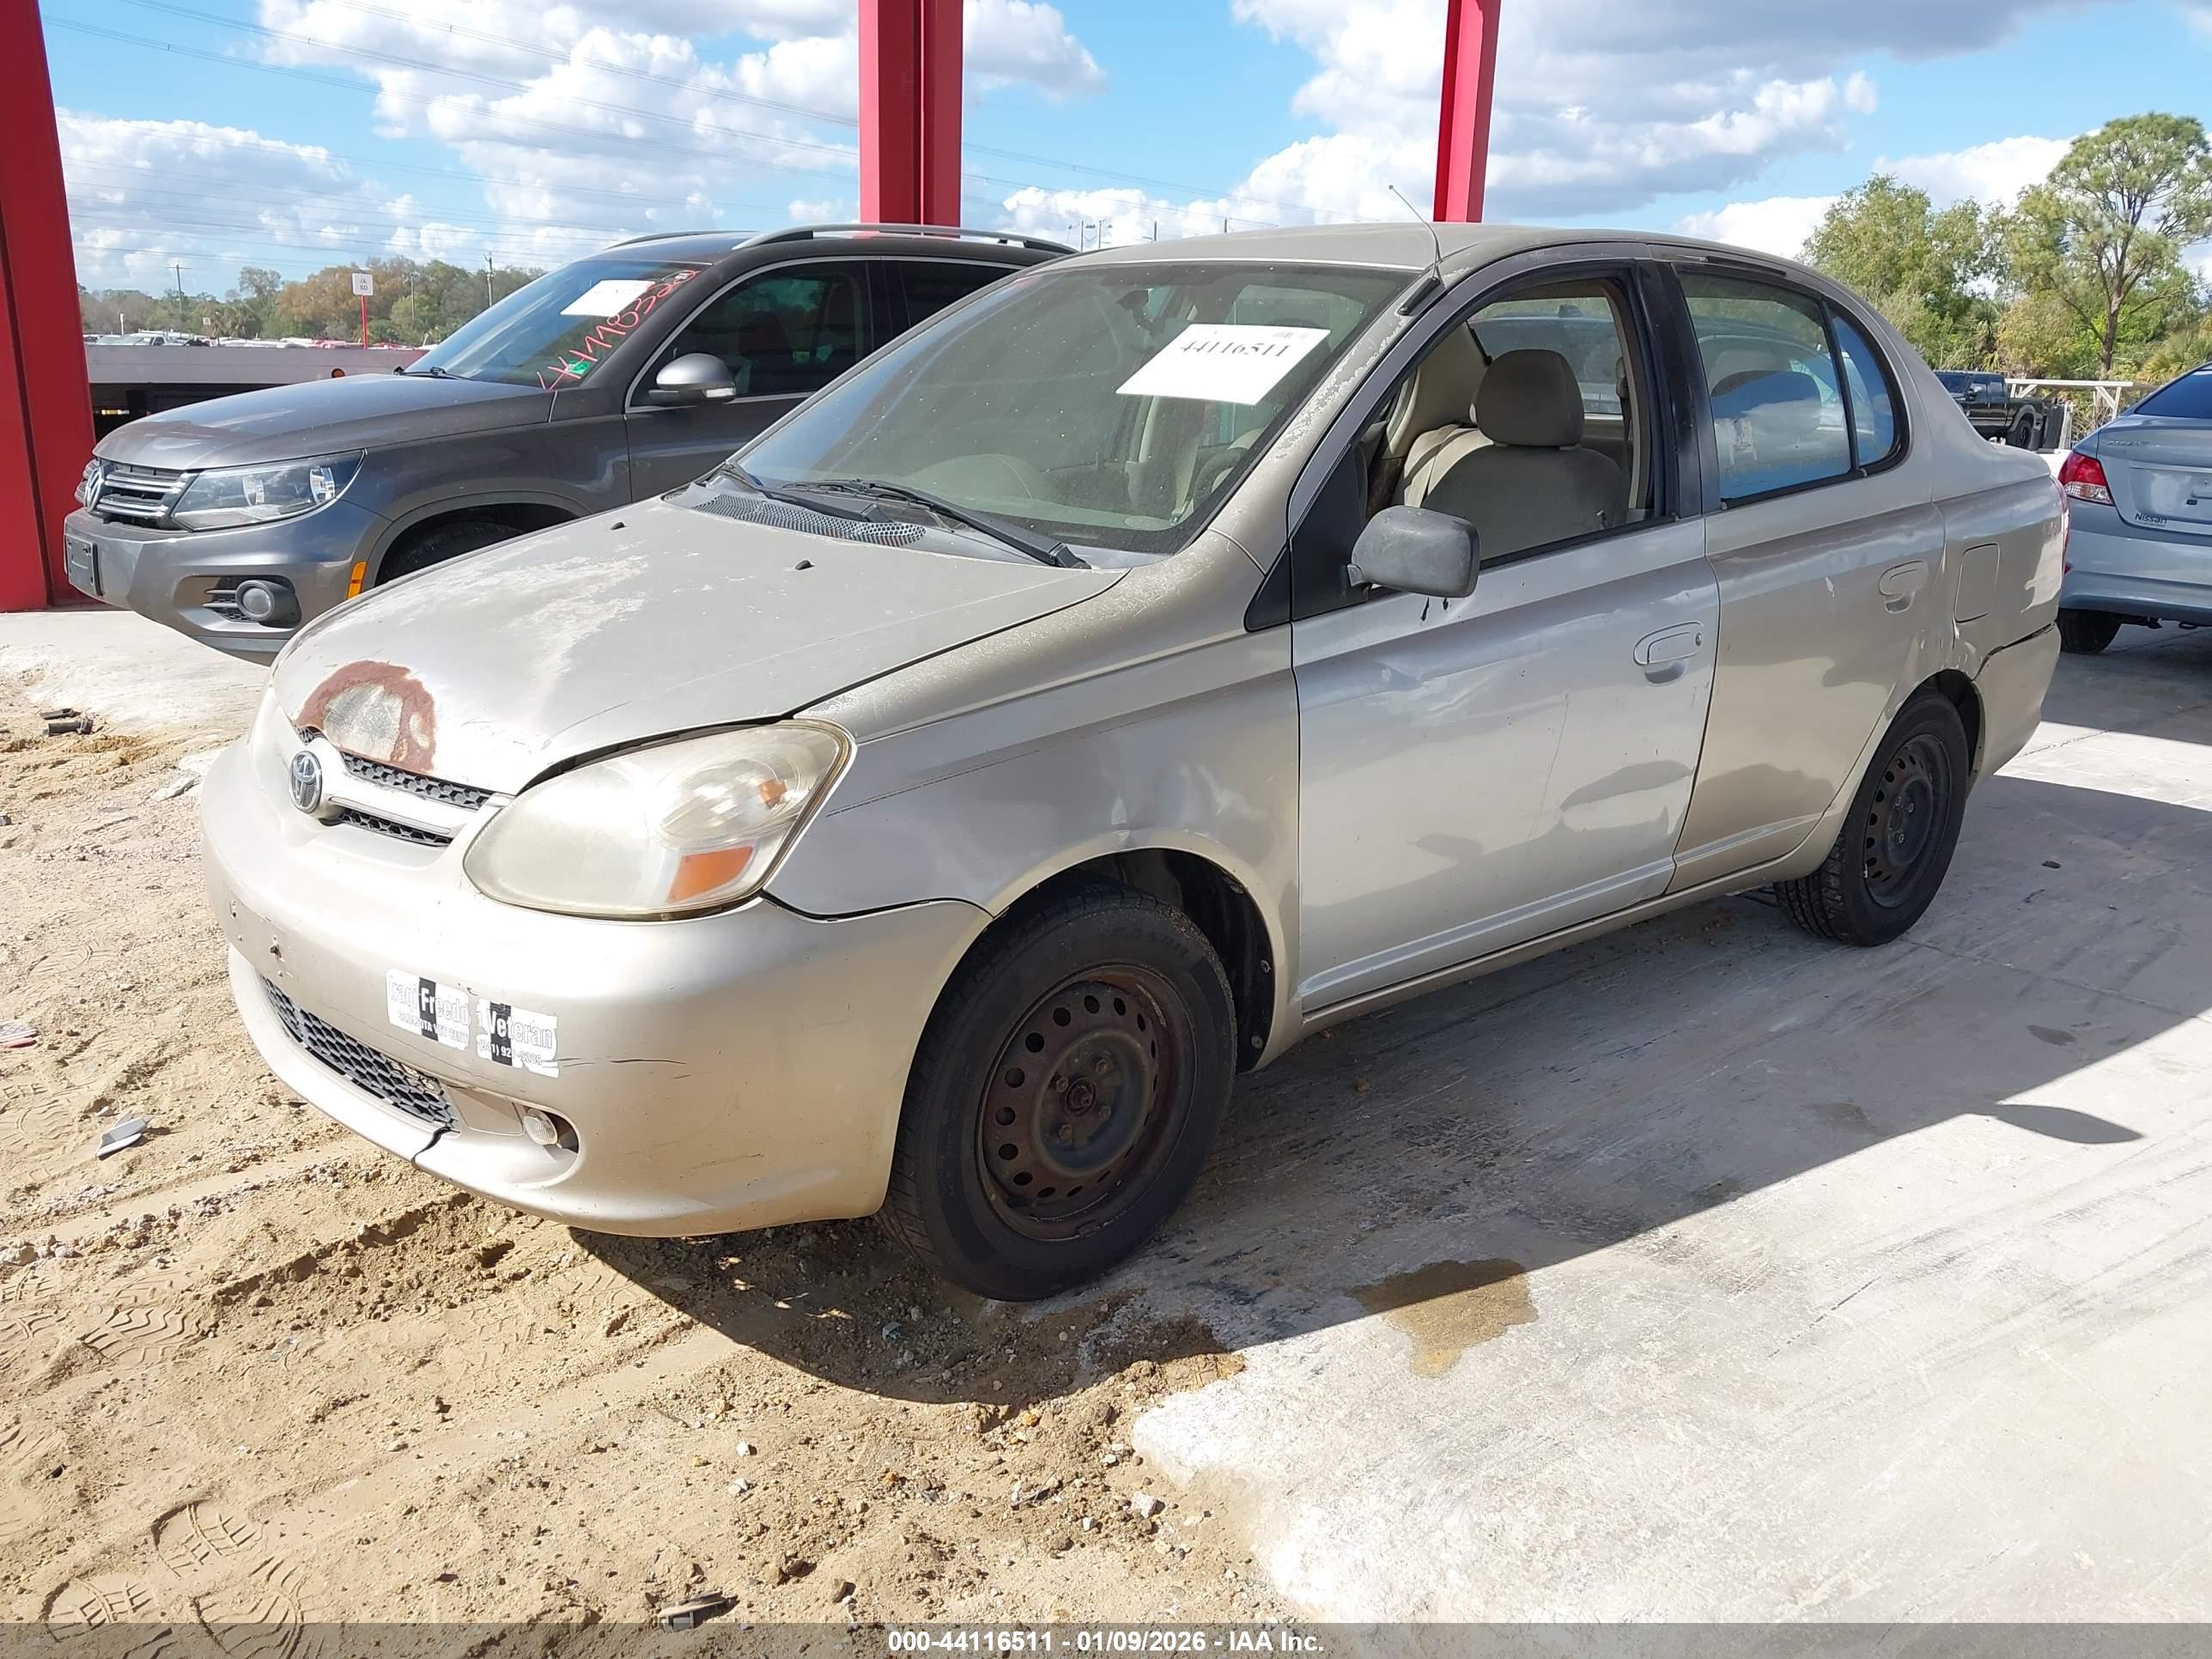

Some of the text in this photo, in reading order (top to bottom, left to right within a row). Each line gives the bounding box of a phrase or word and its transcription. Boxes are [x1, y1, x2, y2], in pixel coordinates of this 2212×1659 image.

[1180, 340, 1290, 357] 44116511
[2135, 513, 2167, 525] Nissan
[487, 1007, 553, 1049] Veteran
